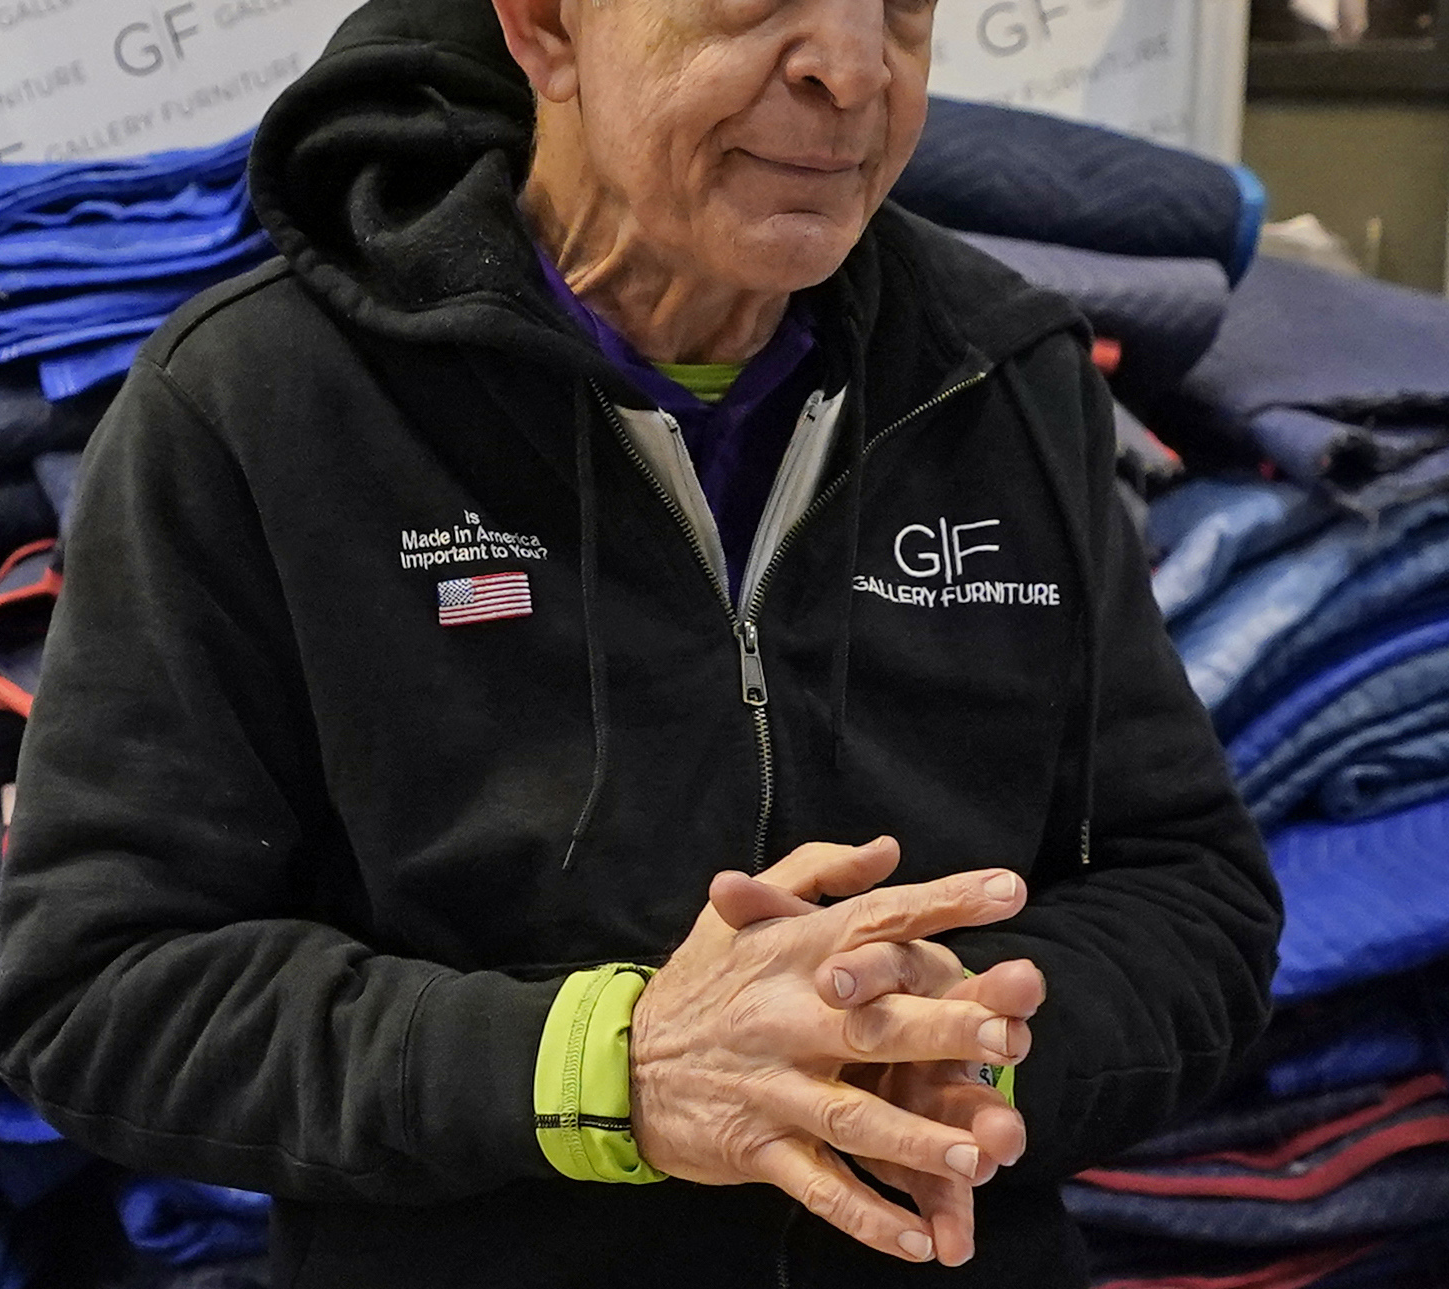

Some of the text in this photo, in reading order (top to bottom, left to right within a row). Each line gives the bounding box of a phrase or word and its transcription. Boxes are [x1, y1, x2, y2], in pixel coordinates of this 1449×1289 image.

[401, 525, 541, 550] Made in America
[400, 543, 548, 570] Important to You?
[852, 576, 1061, 608] GALLERY FURNITURE
